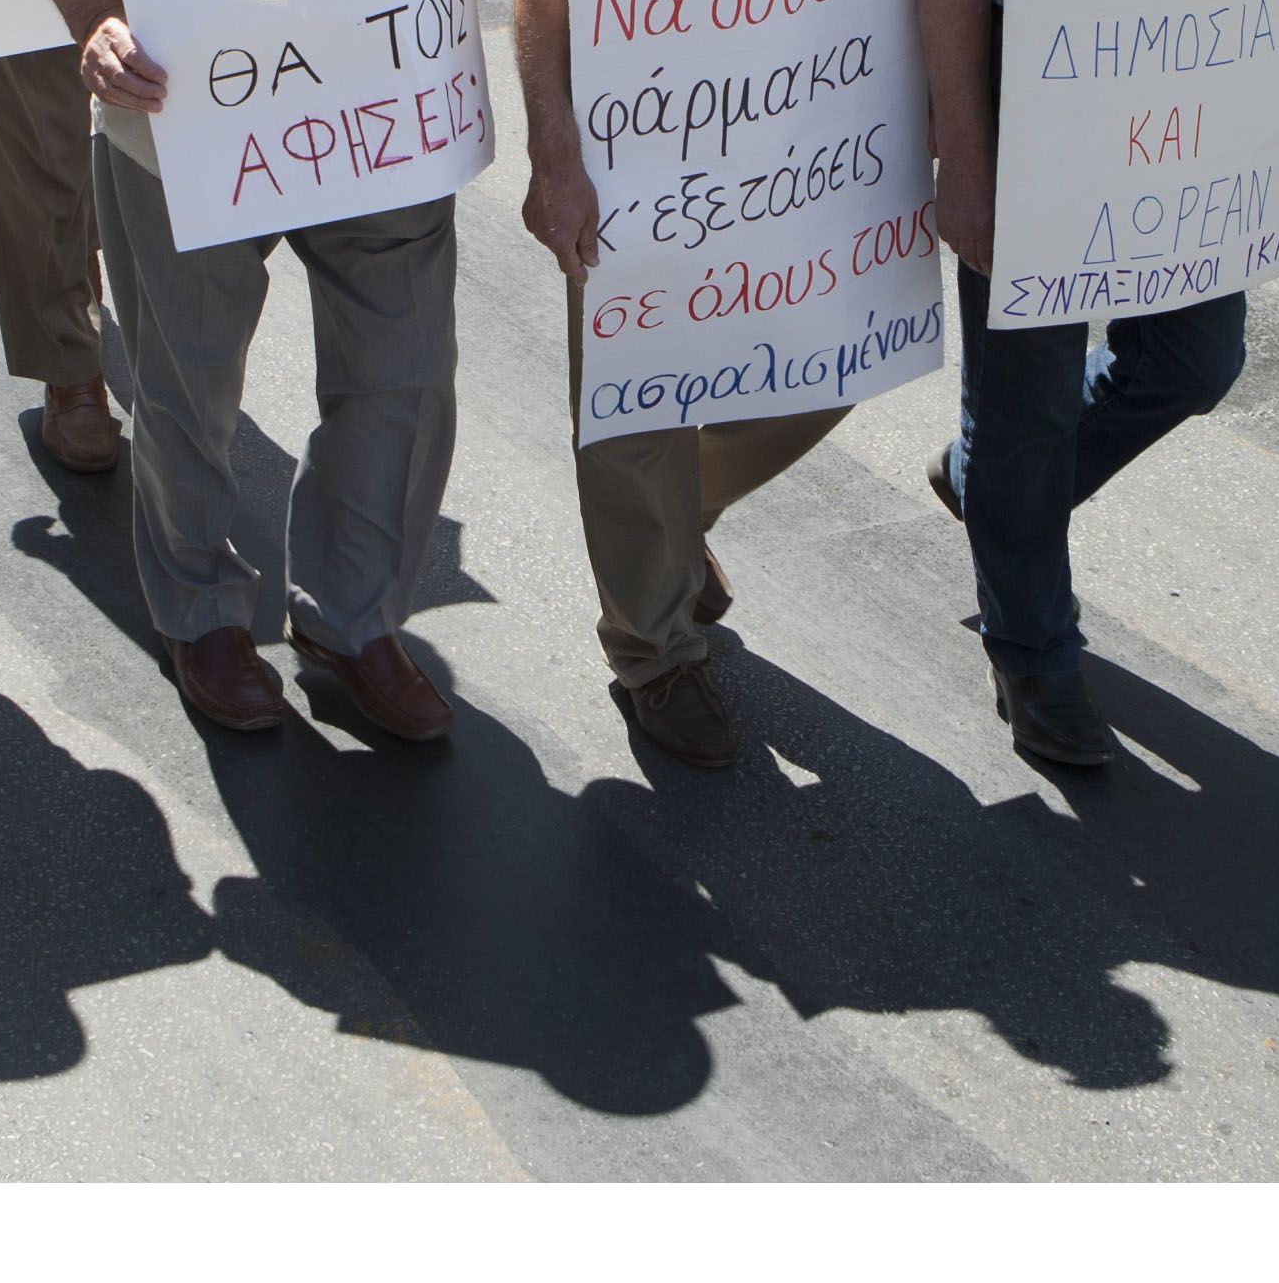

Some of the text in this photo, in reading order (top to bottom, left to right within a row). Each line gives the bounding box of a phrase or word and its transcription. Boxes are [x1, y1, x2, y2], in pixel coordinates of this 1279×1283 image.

[207, 40, 323, 108] ΘΑ
[587, 32, 875, 171] φάρμακα
[651, 121, 889, 252] εξετάσεις
[1127, 102, 1204, 167] ΚΑΙ
[592, 199, 938, 341] σε όλους τους
[1082, 164, 1274, 265] ΔΩΡΕΑΝ
[1002, 254, 1223, 318] ΣΥΝΤΑΞΙΟΥΧΟΙ
[590, 299, 945, 426] ασφαλισμένους
